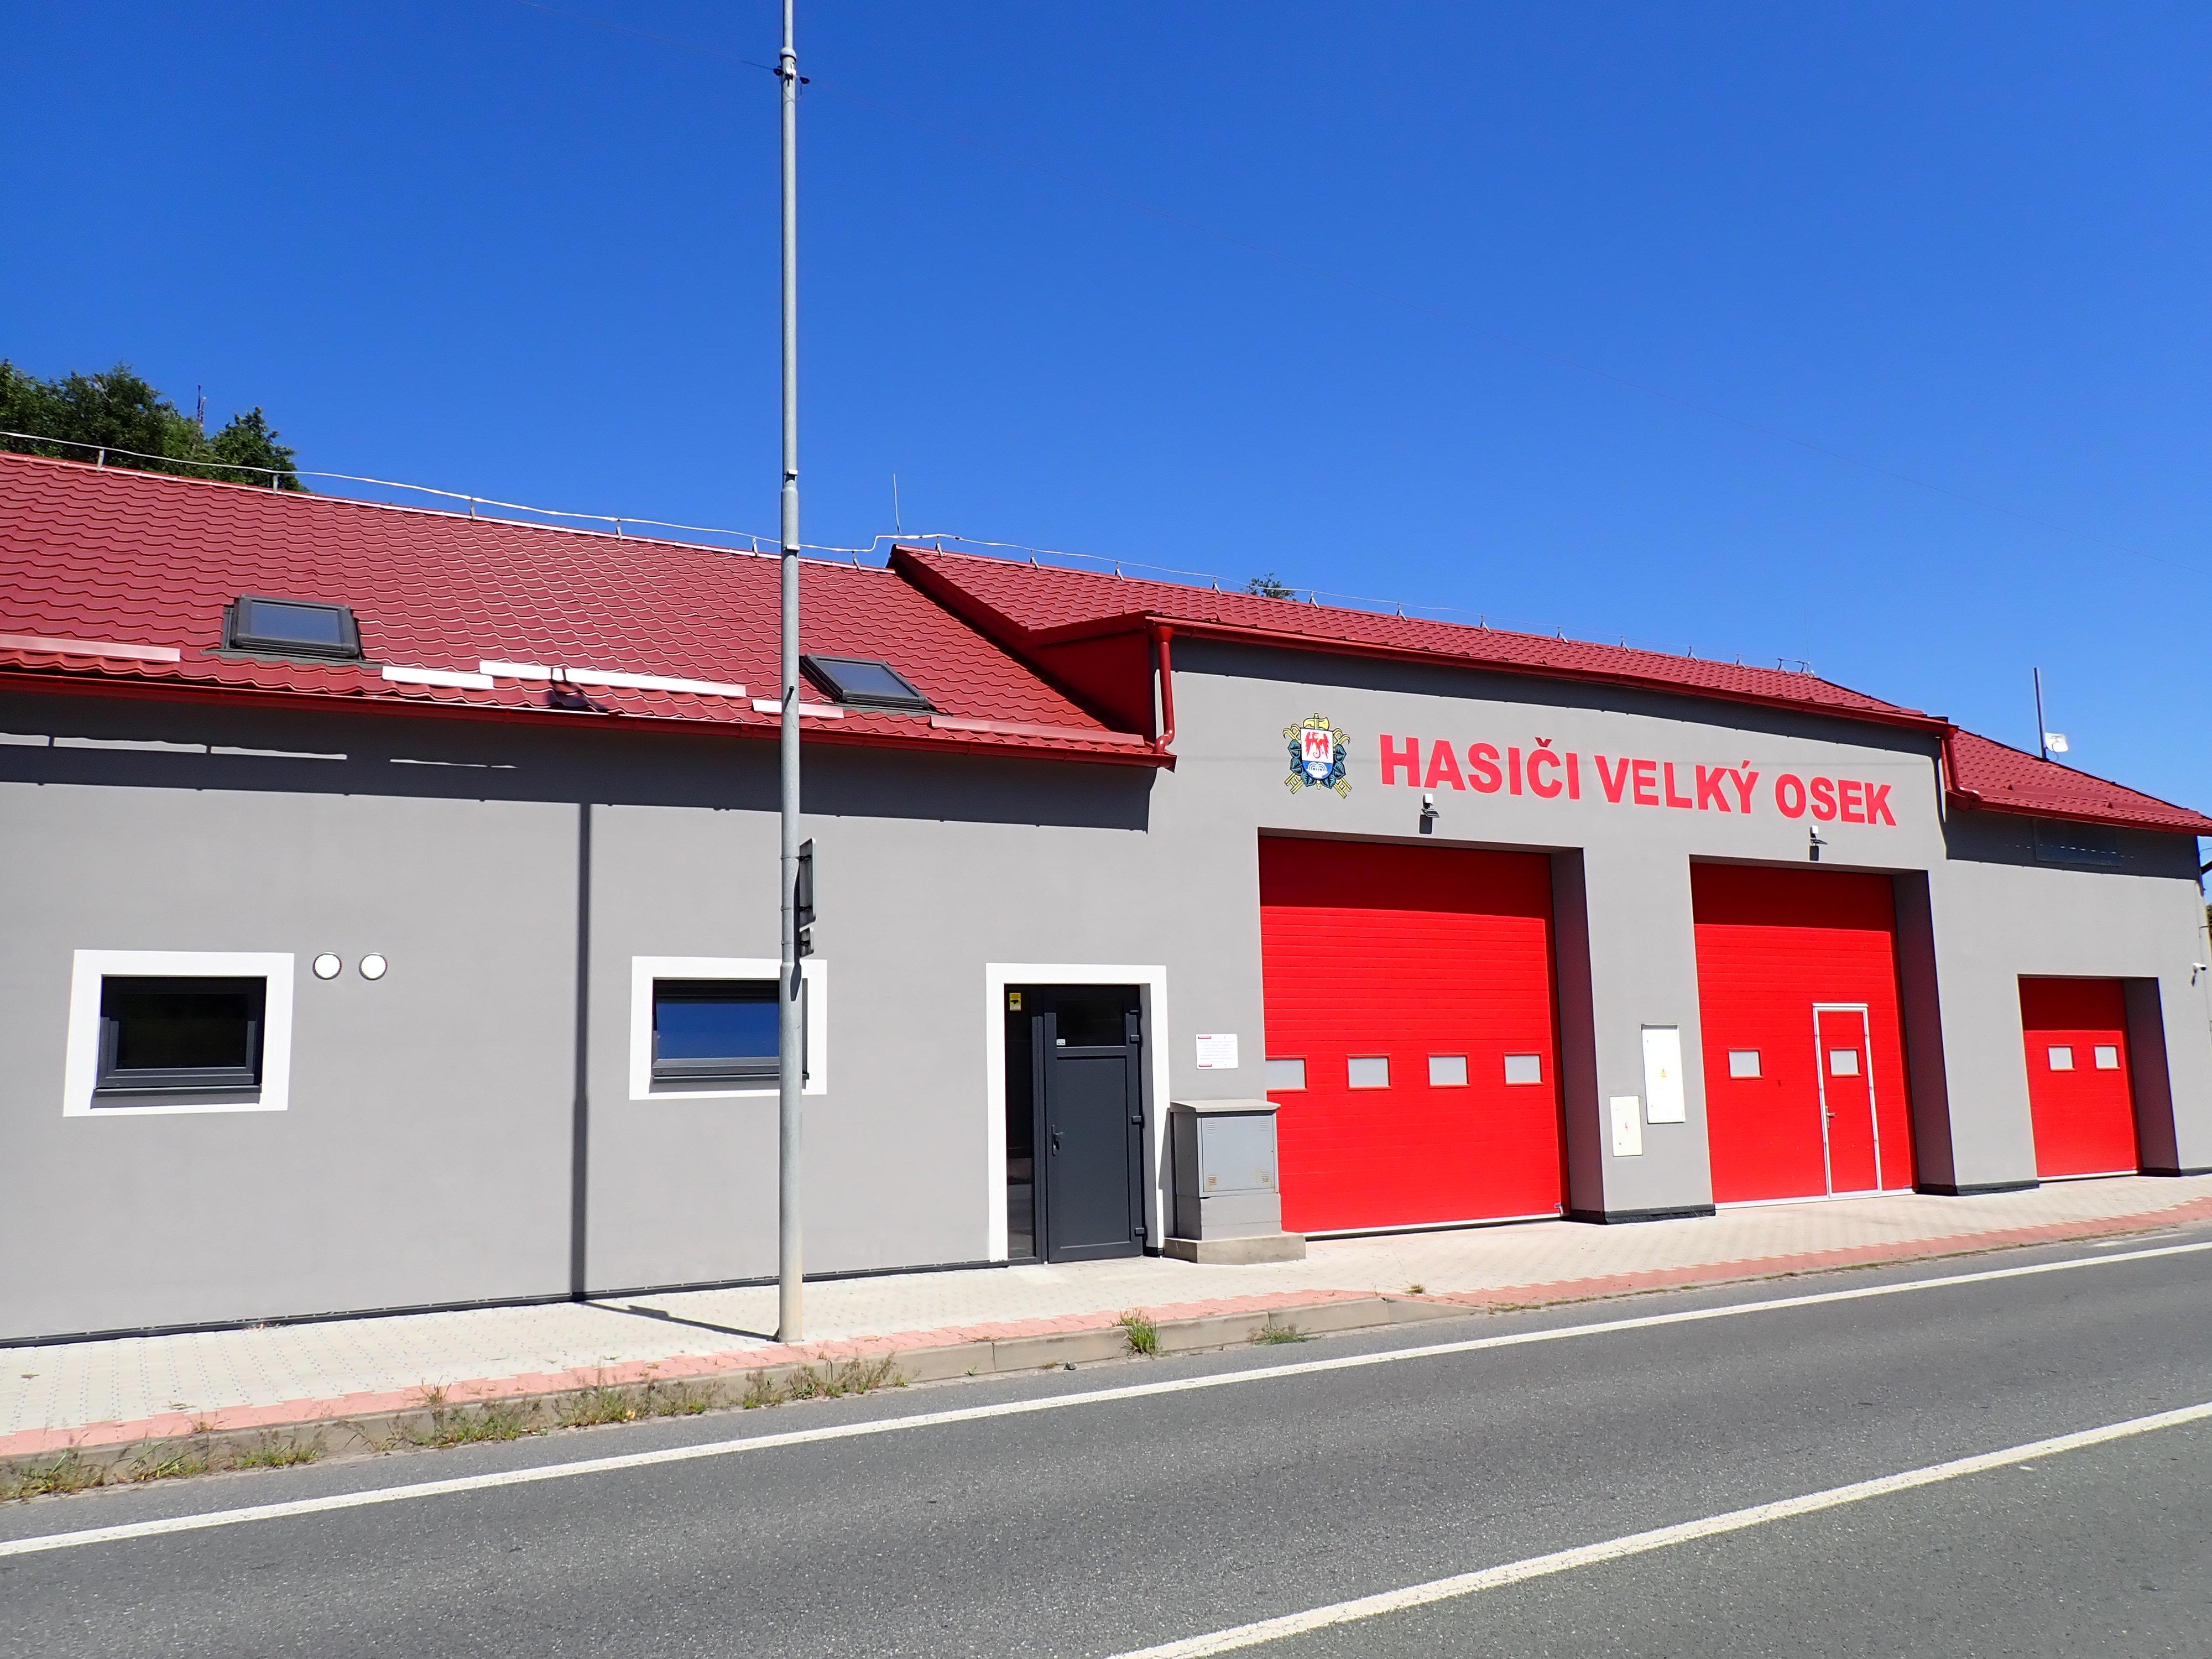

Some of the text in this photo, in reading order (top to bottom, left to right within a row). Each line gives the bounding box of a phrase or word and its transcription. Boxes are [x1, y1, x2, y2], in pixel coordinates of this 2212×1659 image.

[1380, 734, 1897, 827] HASIČI VELKÝ OSEK
